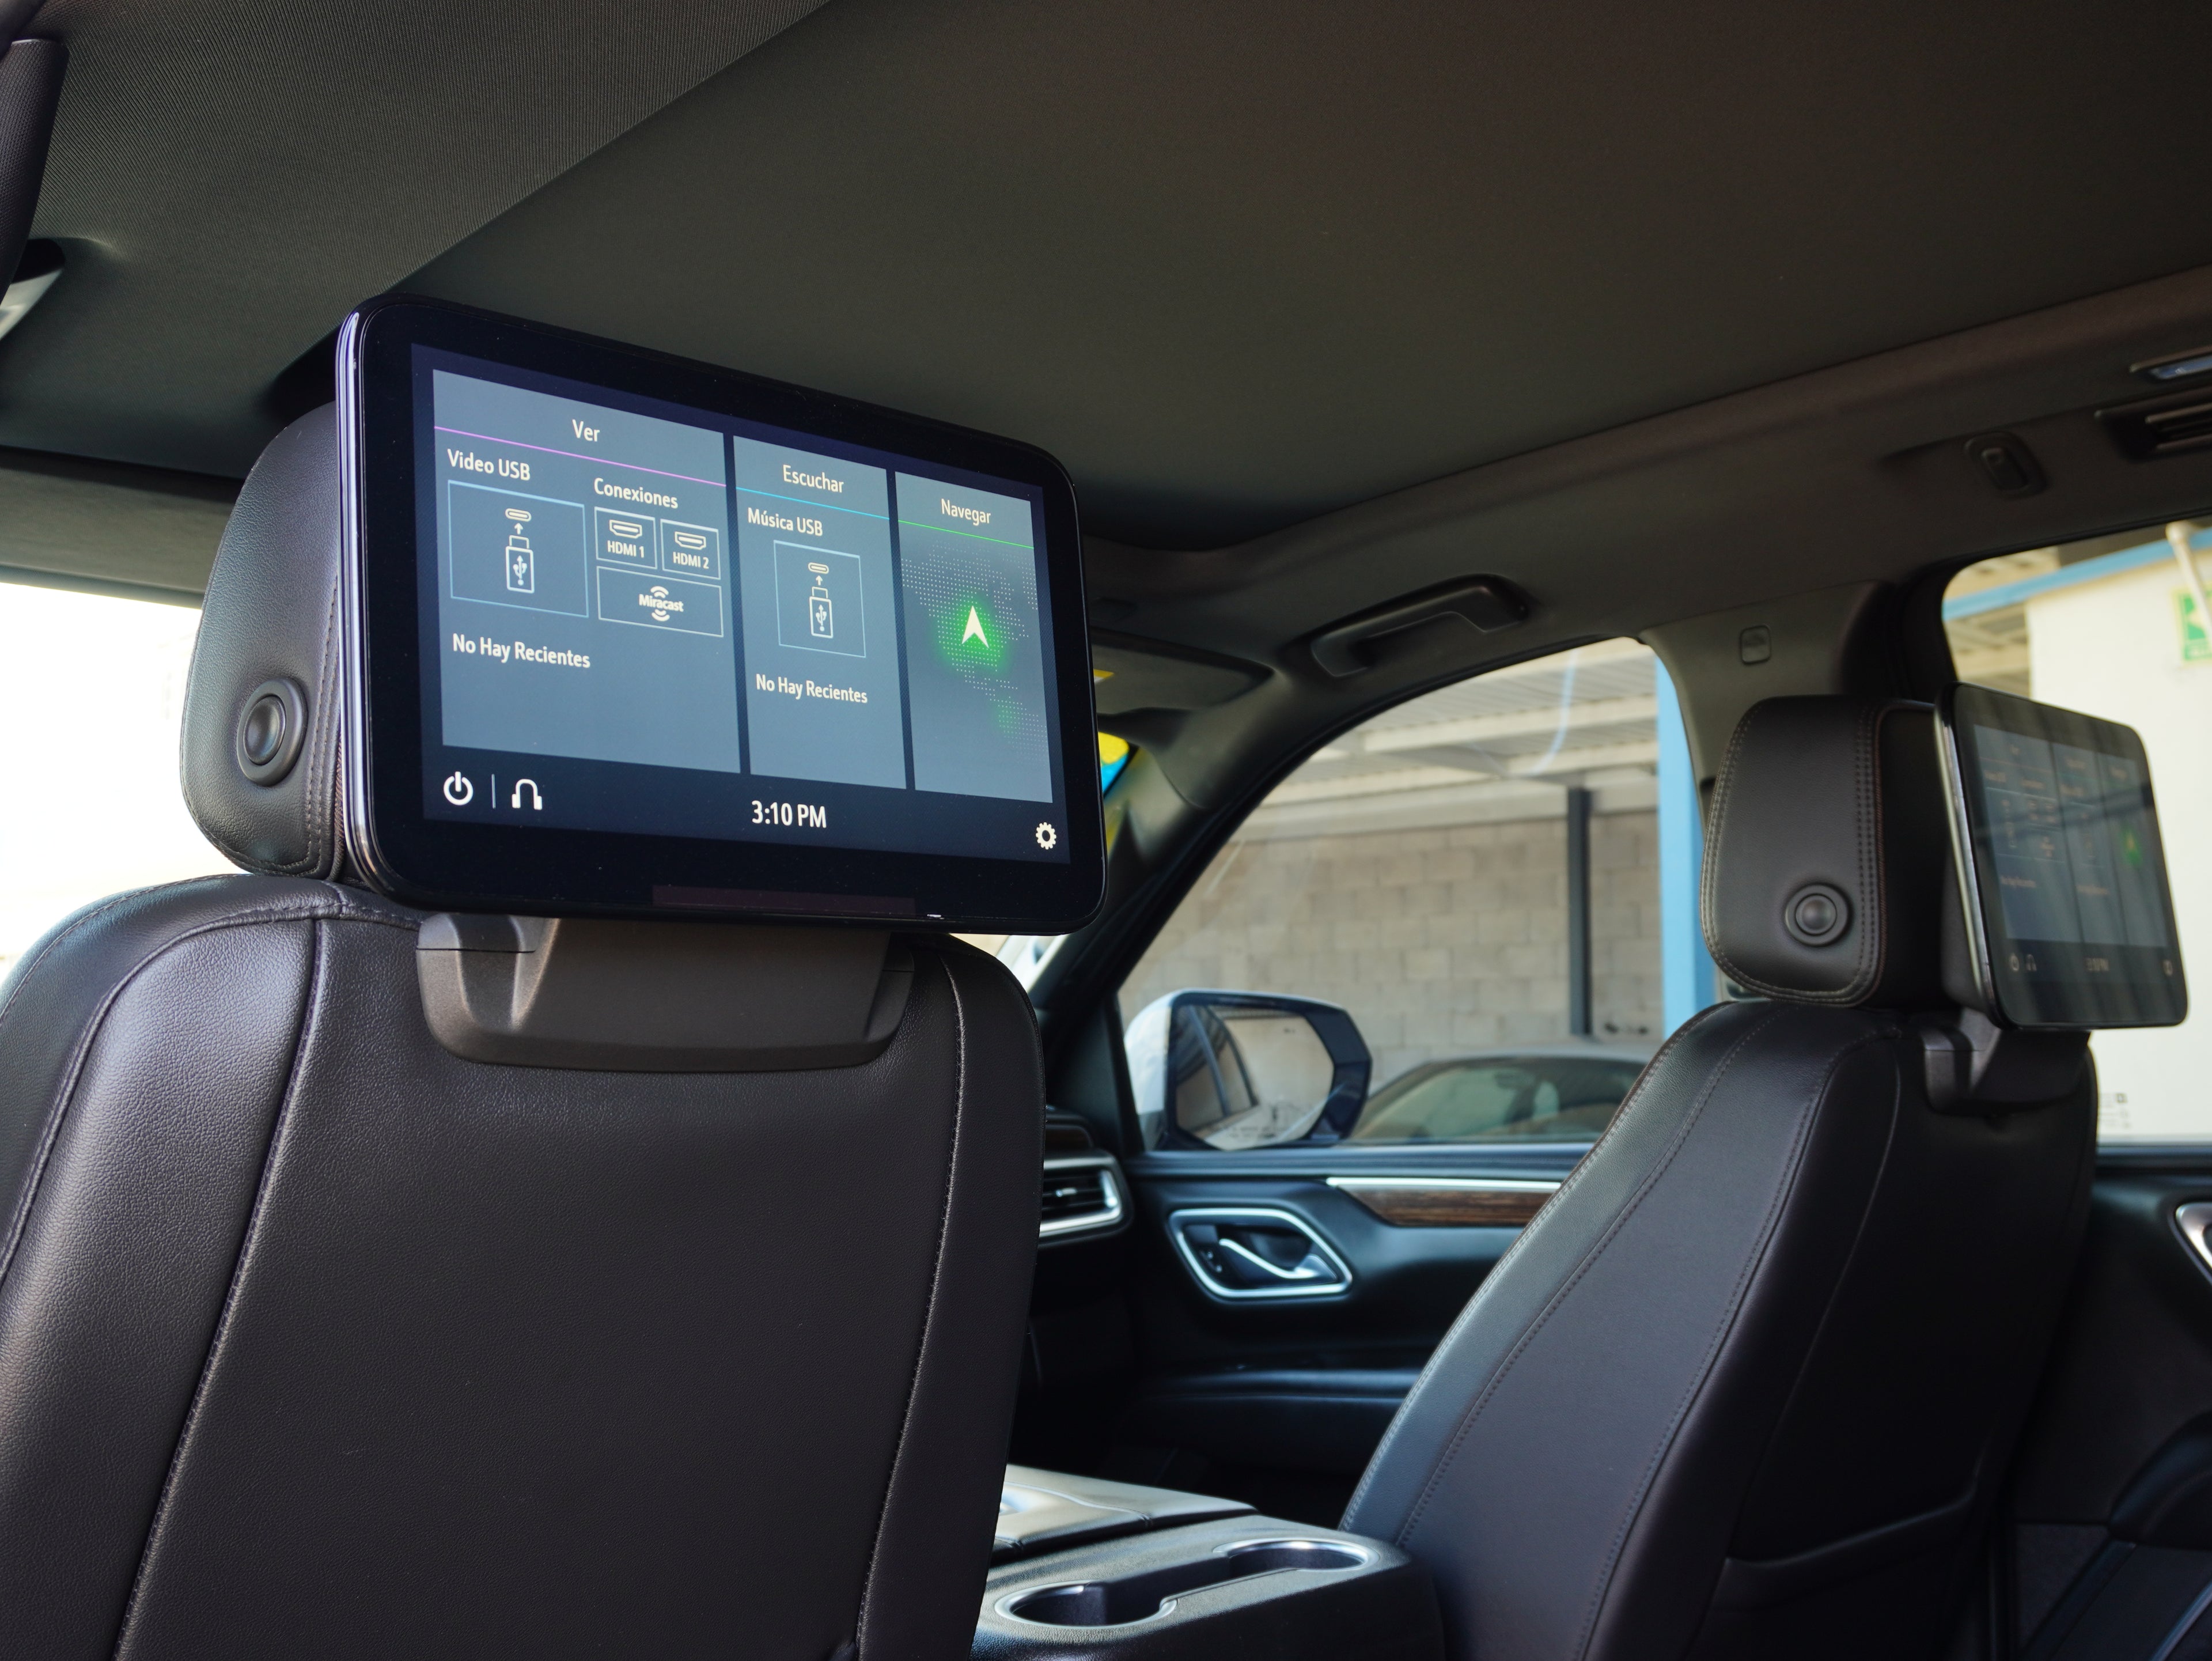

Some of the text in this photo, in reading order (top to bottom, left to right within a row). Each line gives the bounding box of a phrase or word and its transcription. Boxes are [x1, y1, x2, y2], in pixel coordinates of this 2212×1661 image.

[572, 419, 600, 442] Ver
[447, 449, 531, 481] Video USB
[782, 464, 844, 493] Escuchar
[594, 477, 679, 509] Conexiones
[748, 507, 823, 536] Música USB
[941, 498, 991, 525] Navegar
[607, 539, 645, 558] HDMI 1
[673, 551, 709, 569] HDMI 2
[639, 593, 684, 612] Miracast
[452, 633, 591, 668] No Hay Recientes
[756, 674, 868, 704] No Hay Recientes
[751, 800, 827, 828] 3:10 PM
